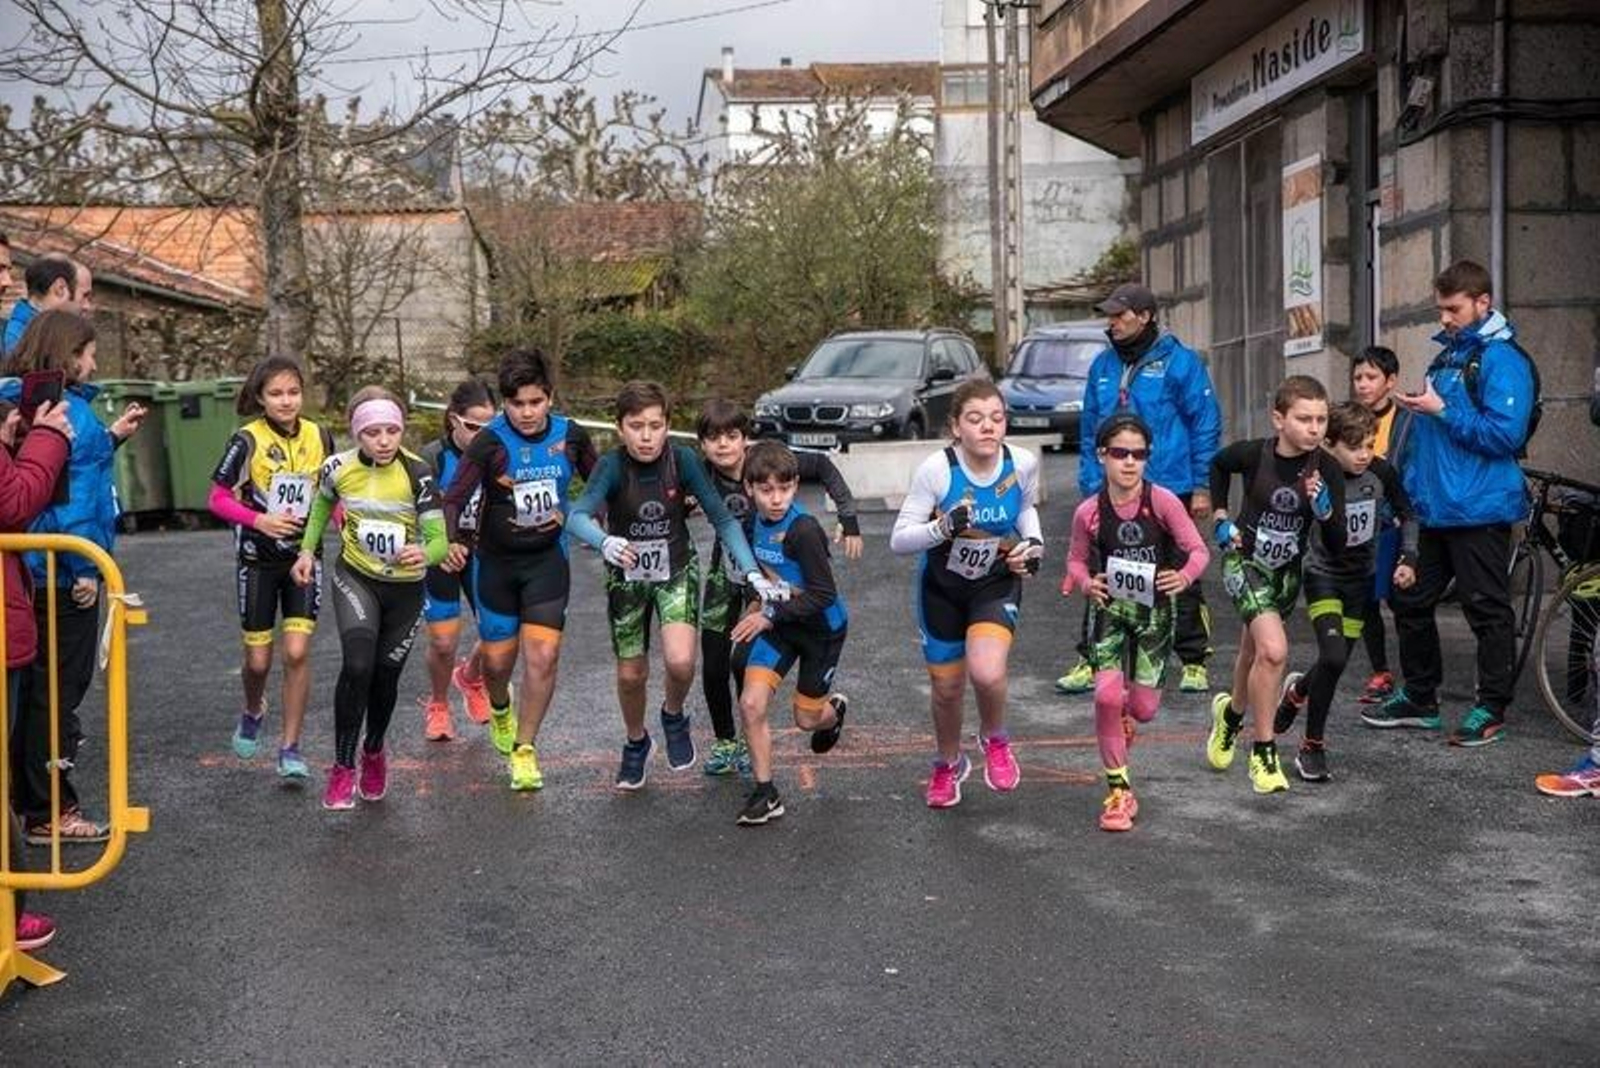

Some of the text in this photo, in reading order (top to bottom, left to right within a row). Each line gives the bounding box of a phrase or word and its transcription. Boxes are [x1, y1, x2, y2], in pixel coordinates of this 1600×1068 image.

[1252, 16, 1331, 94] Maside
[277, 483, 305, 505] 904
[523, 491, 553, 515] 910
[969, 505, 1008, 523] AOLA
[1258, 511, 1304, 530] ARAUJO
[1345, 512, 1368, 533] 09
[629, 519, 671, 537] GOMEZ
[366, 532, 395, 555] 901
[1262, 541, 1292, 560] 905
[959, 547, 990, 568] 902
[1115, 571, 1145, 592] 900
